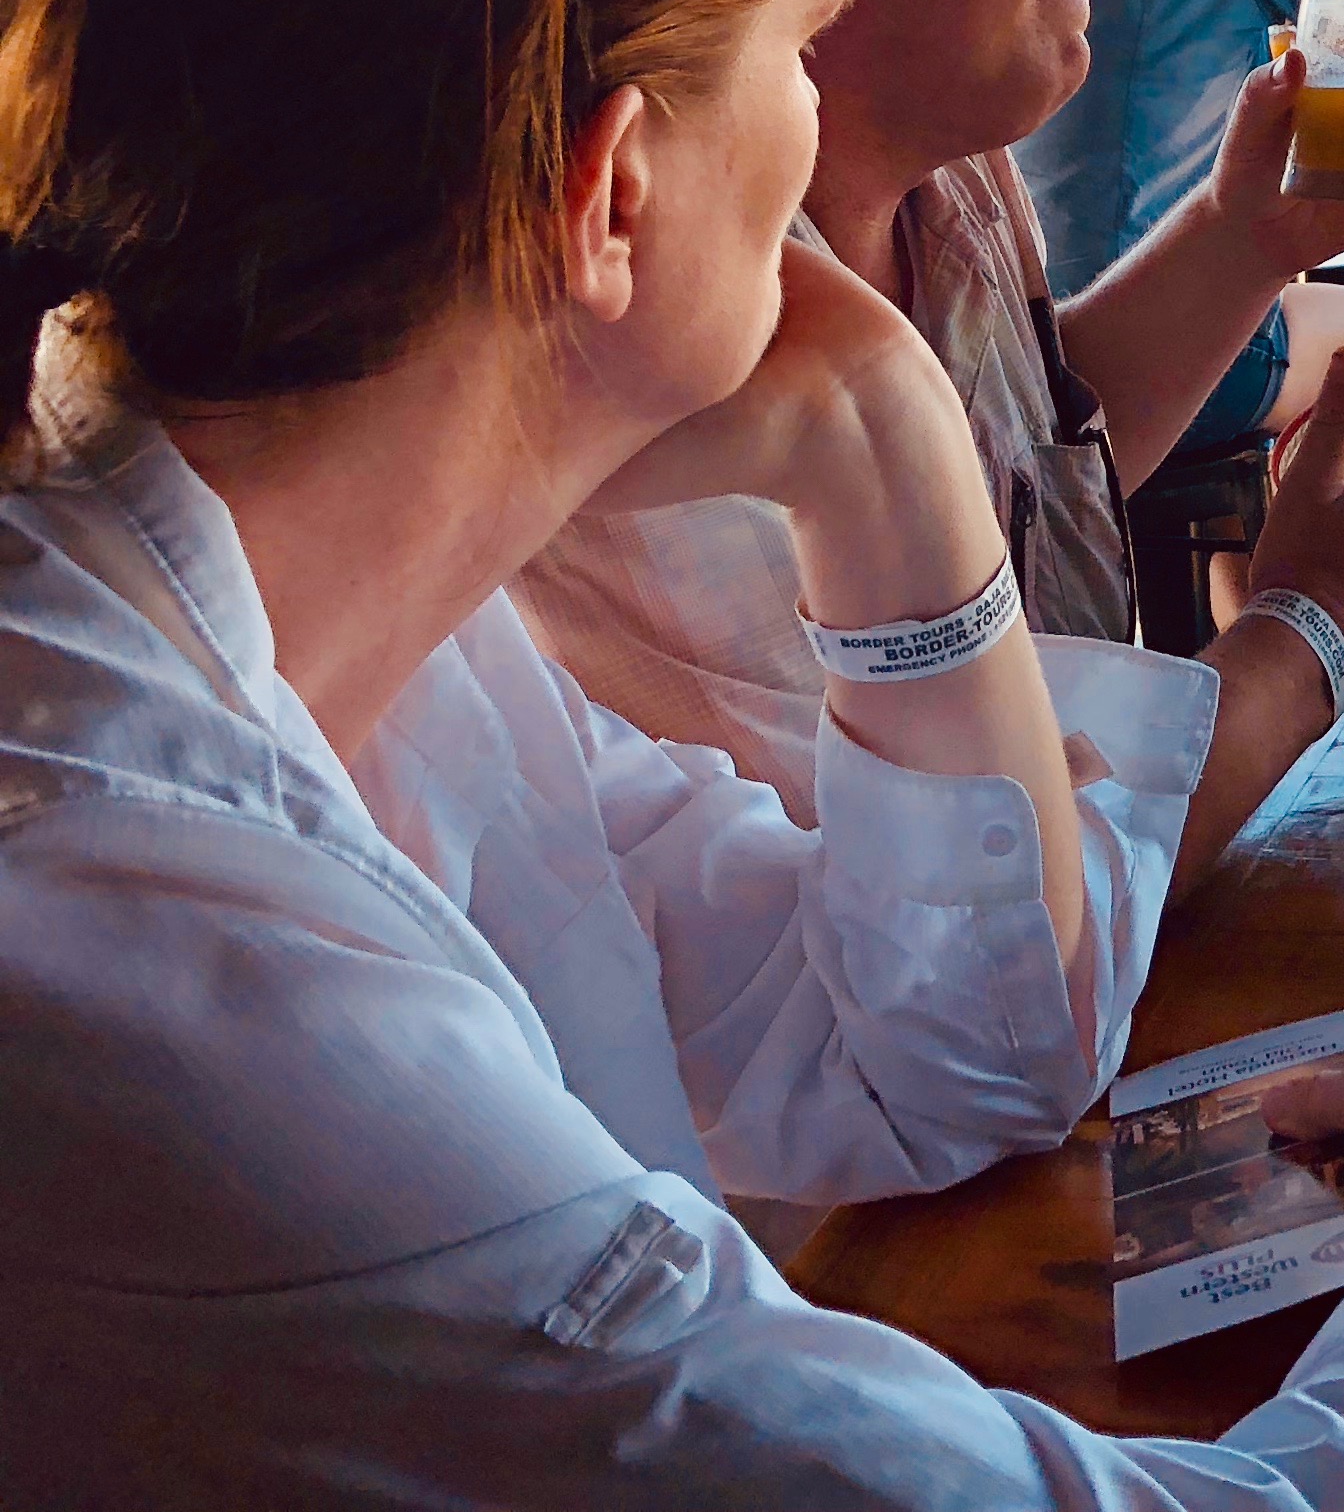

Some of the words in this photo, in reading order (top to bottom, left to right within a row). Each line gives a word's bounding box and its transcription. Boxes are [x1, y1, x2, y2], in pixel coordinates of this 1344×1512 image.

[840, 636, 906, 649] BORDER
[910, 617, 965, 642] TOURS
[975, 587, 1001, 617] BAJA
[868, 654, 946, 674] EMERGENCY
[949, 634, 987, 659] PHONE
[1179, 1256, 1298, 1298] Western
[1210, 1276, 1272, 1303] Best
